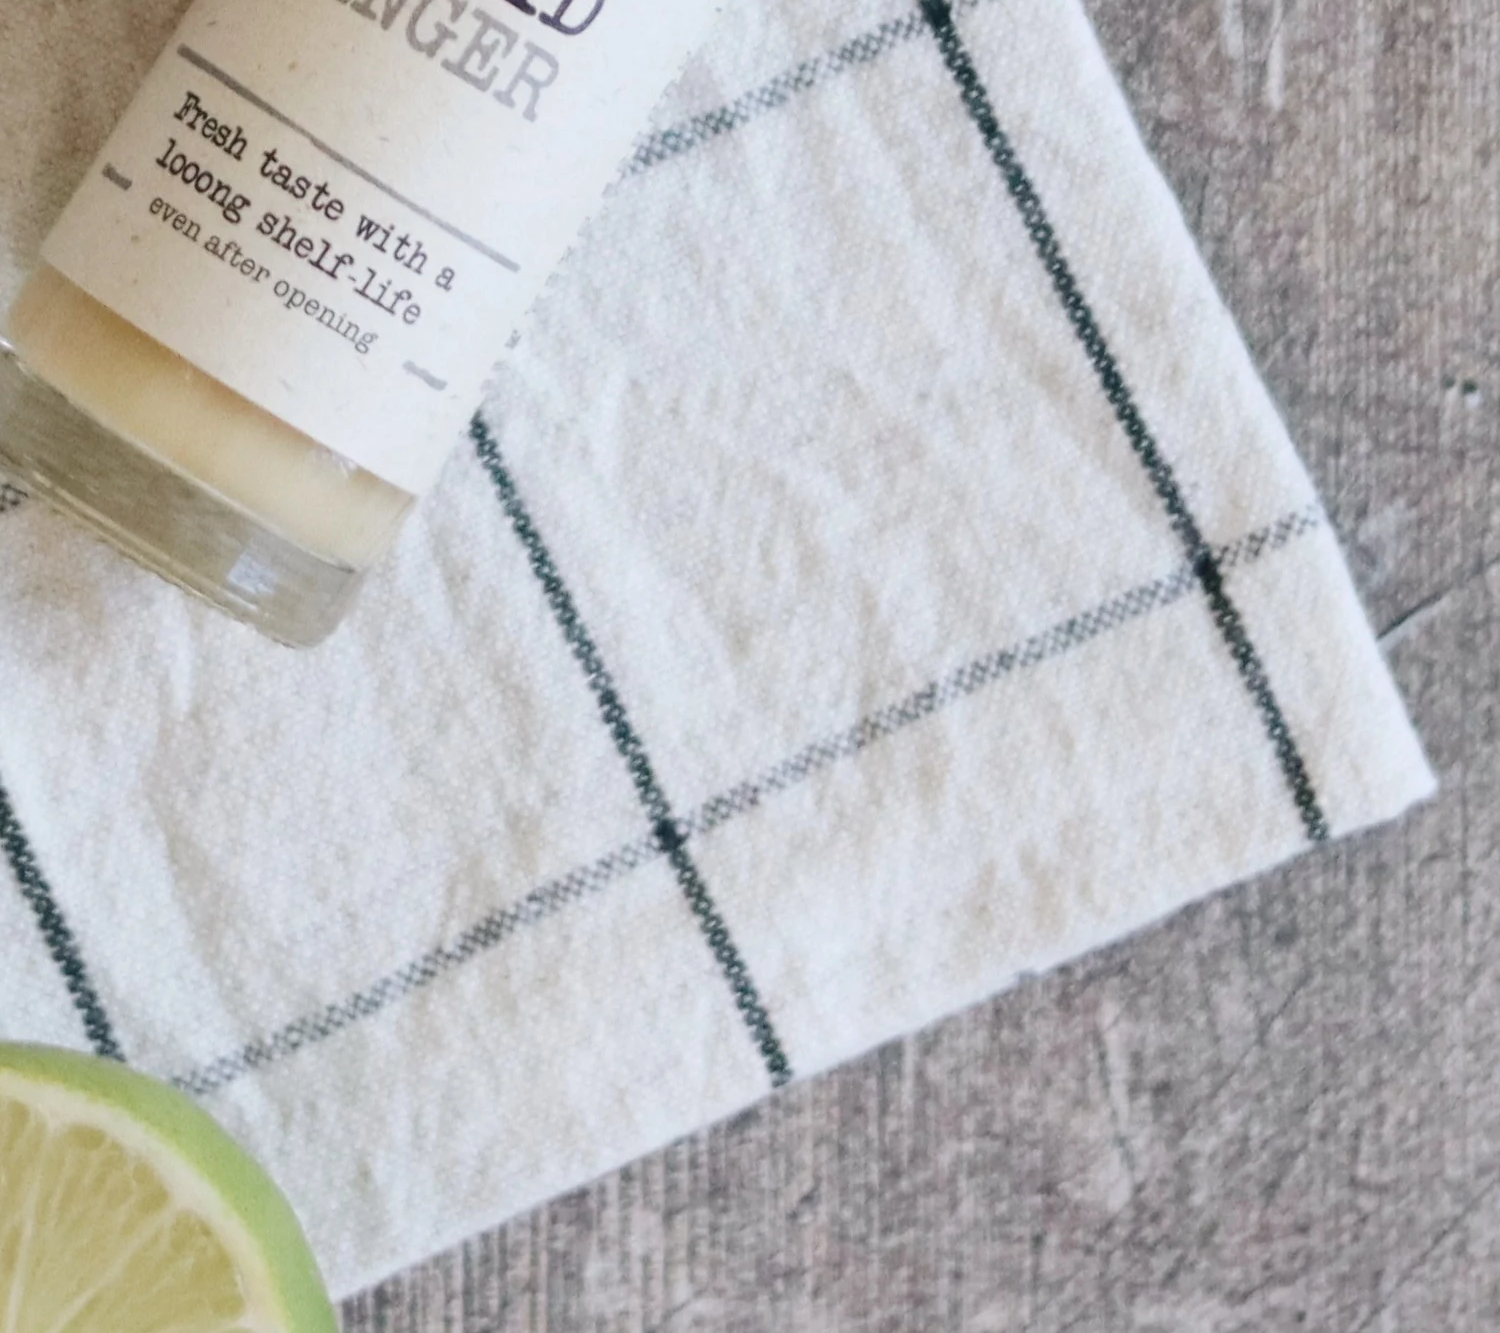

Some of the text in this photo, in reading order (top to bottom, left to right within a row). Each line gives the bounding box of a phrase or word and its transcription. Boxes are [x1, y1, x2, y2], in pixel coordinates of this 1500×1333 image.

[149, 195, 379, 355] even after opening
[155, 139, 422, 325] looong shelf-life
[173, 91, 456, 291] Fresh taste with a
